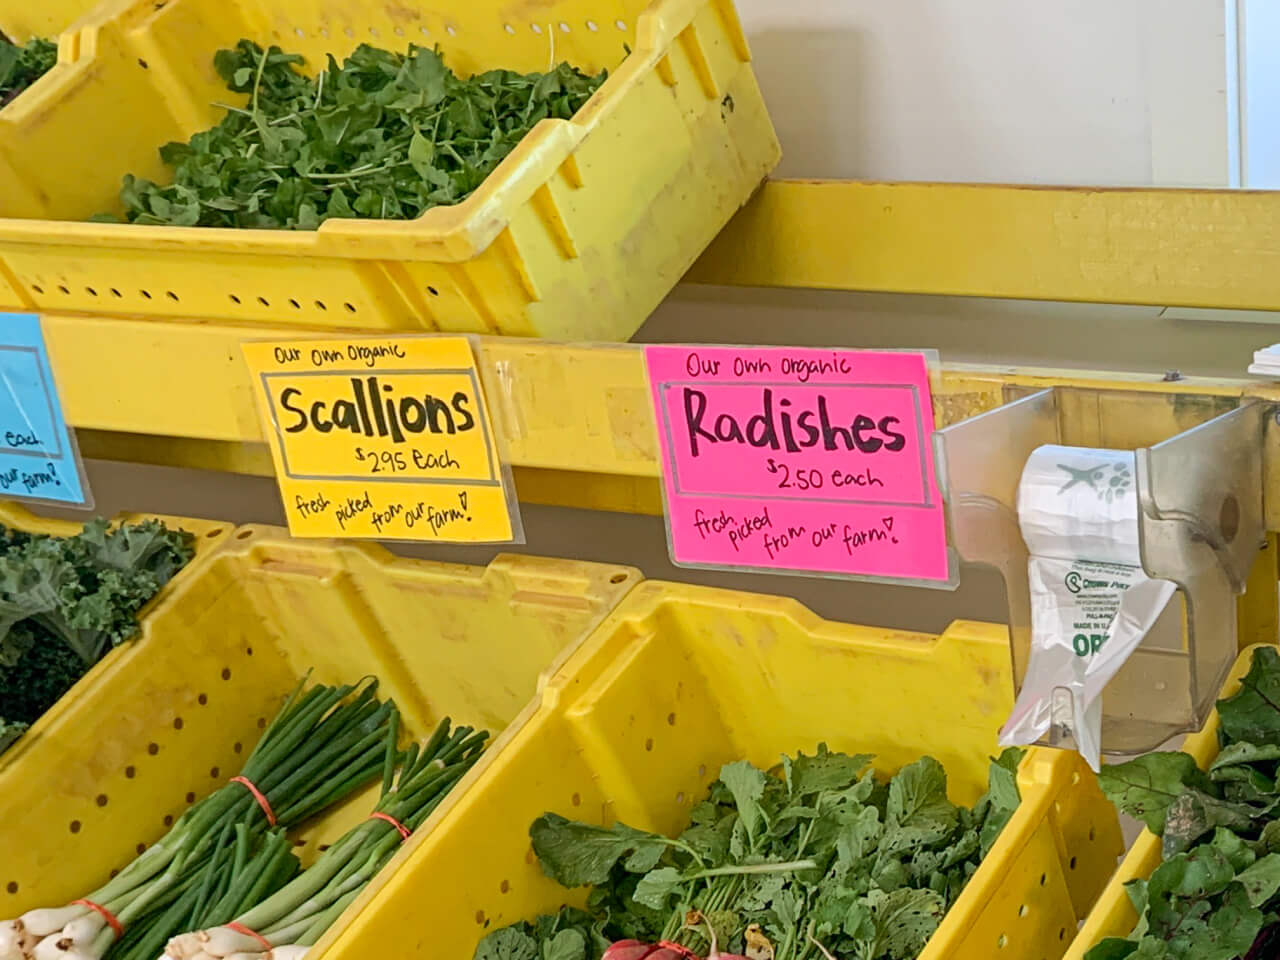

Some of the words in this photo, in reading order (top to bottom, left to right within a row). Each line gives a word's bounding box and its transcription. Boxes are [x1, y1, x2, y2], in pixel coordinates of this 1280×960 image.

[686, 352, 720, 377] Our
[280, 377, 475, 443] Scallions
[684, 388, 906, 457] Radishes
[355, 448, 407, 472] $2.95
[412, 449, 460, 470] each
[767, 459, 823, 490] $2.50
[832, 468, 884, 487] each
[296, 493, 330, 519] fresh
[336, 491, 373, 530] picked
[371, 504, 403, 533] from
[405, 503, 425, 528] our
[694, 509, 734, 539] fresh
[729, 506, 773, 552] picked
[763, 526, 806, 559] from
[812, 523, 837, 547] our
